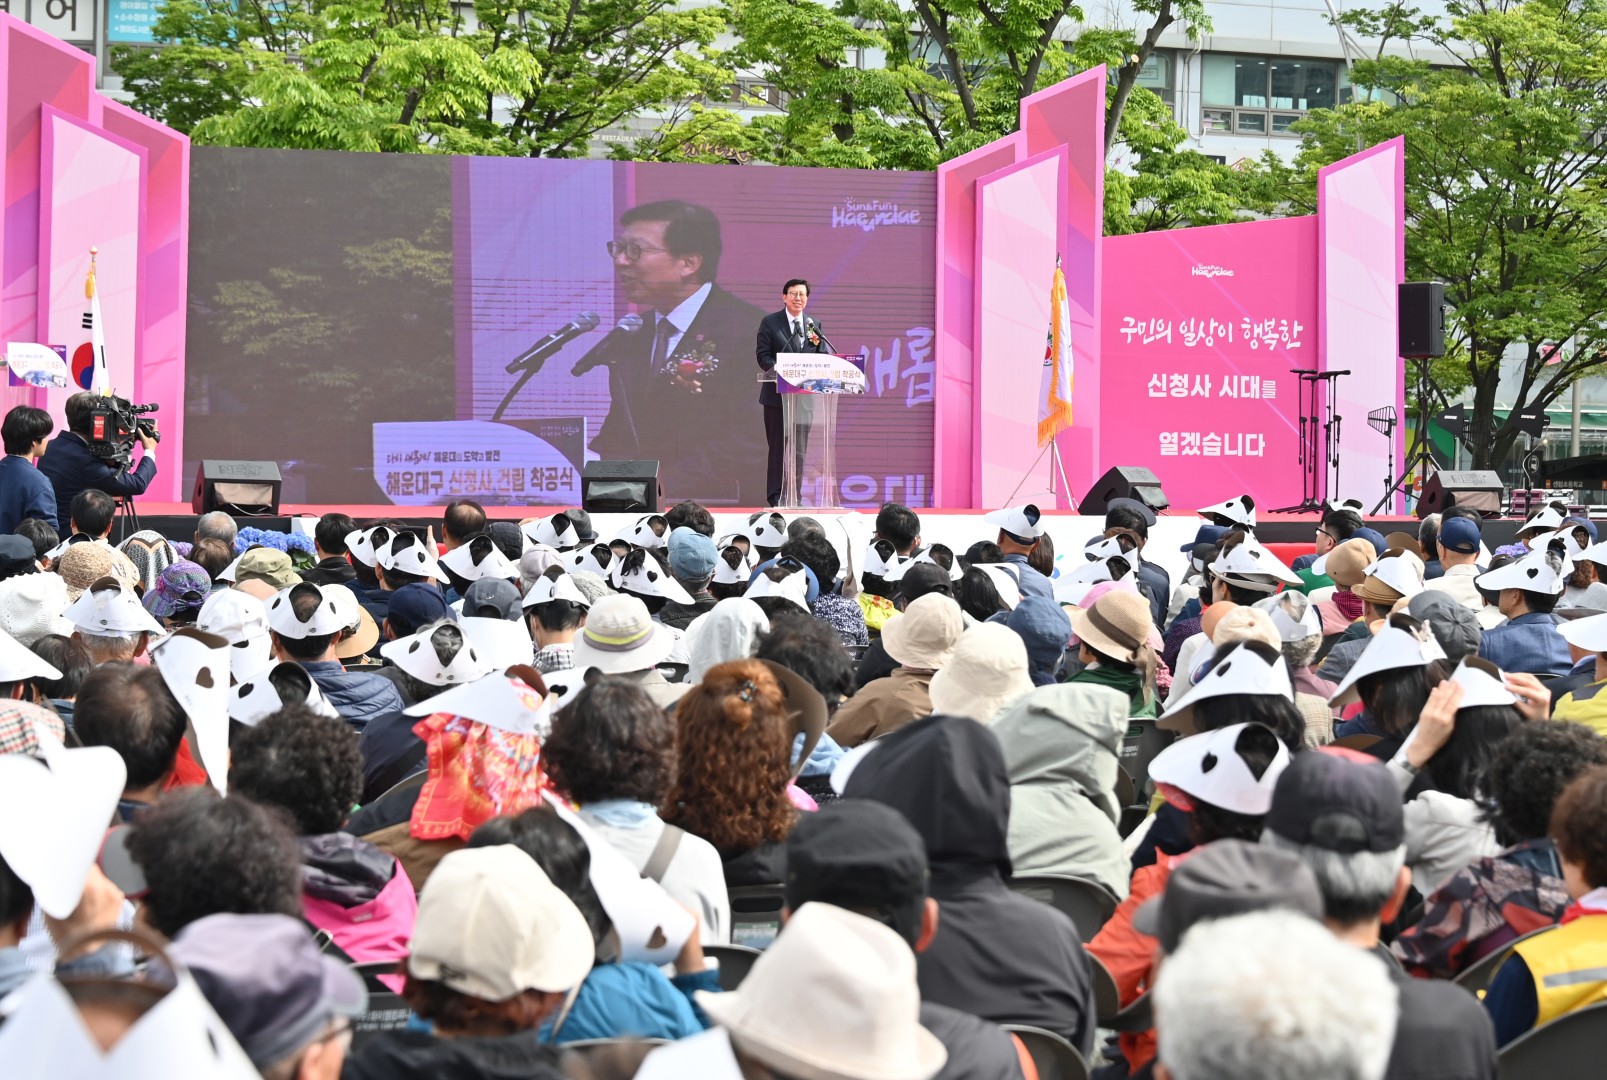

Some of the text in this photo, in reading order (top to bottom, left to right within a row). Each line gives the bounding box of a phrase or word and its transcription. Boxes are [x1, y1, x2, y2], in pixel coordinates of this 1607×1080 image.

[846, 199, 892, 211] Sun&Fun
[1120, 316, 1304, 350] 구민의 일상이 행복한
[842, 369, 861, 379] 착공식
[1147, 373, 1277, 399] 신청사 시대를
[1159, 432, 1266, 457] 열겠습니다
[386, 466, 574, 497] 해운대구 신청사 건립 착공식
